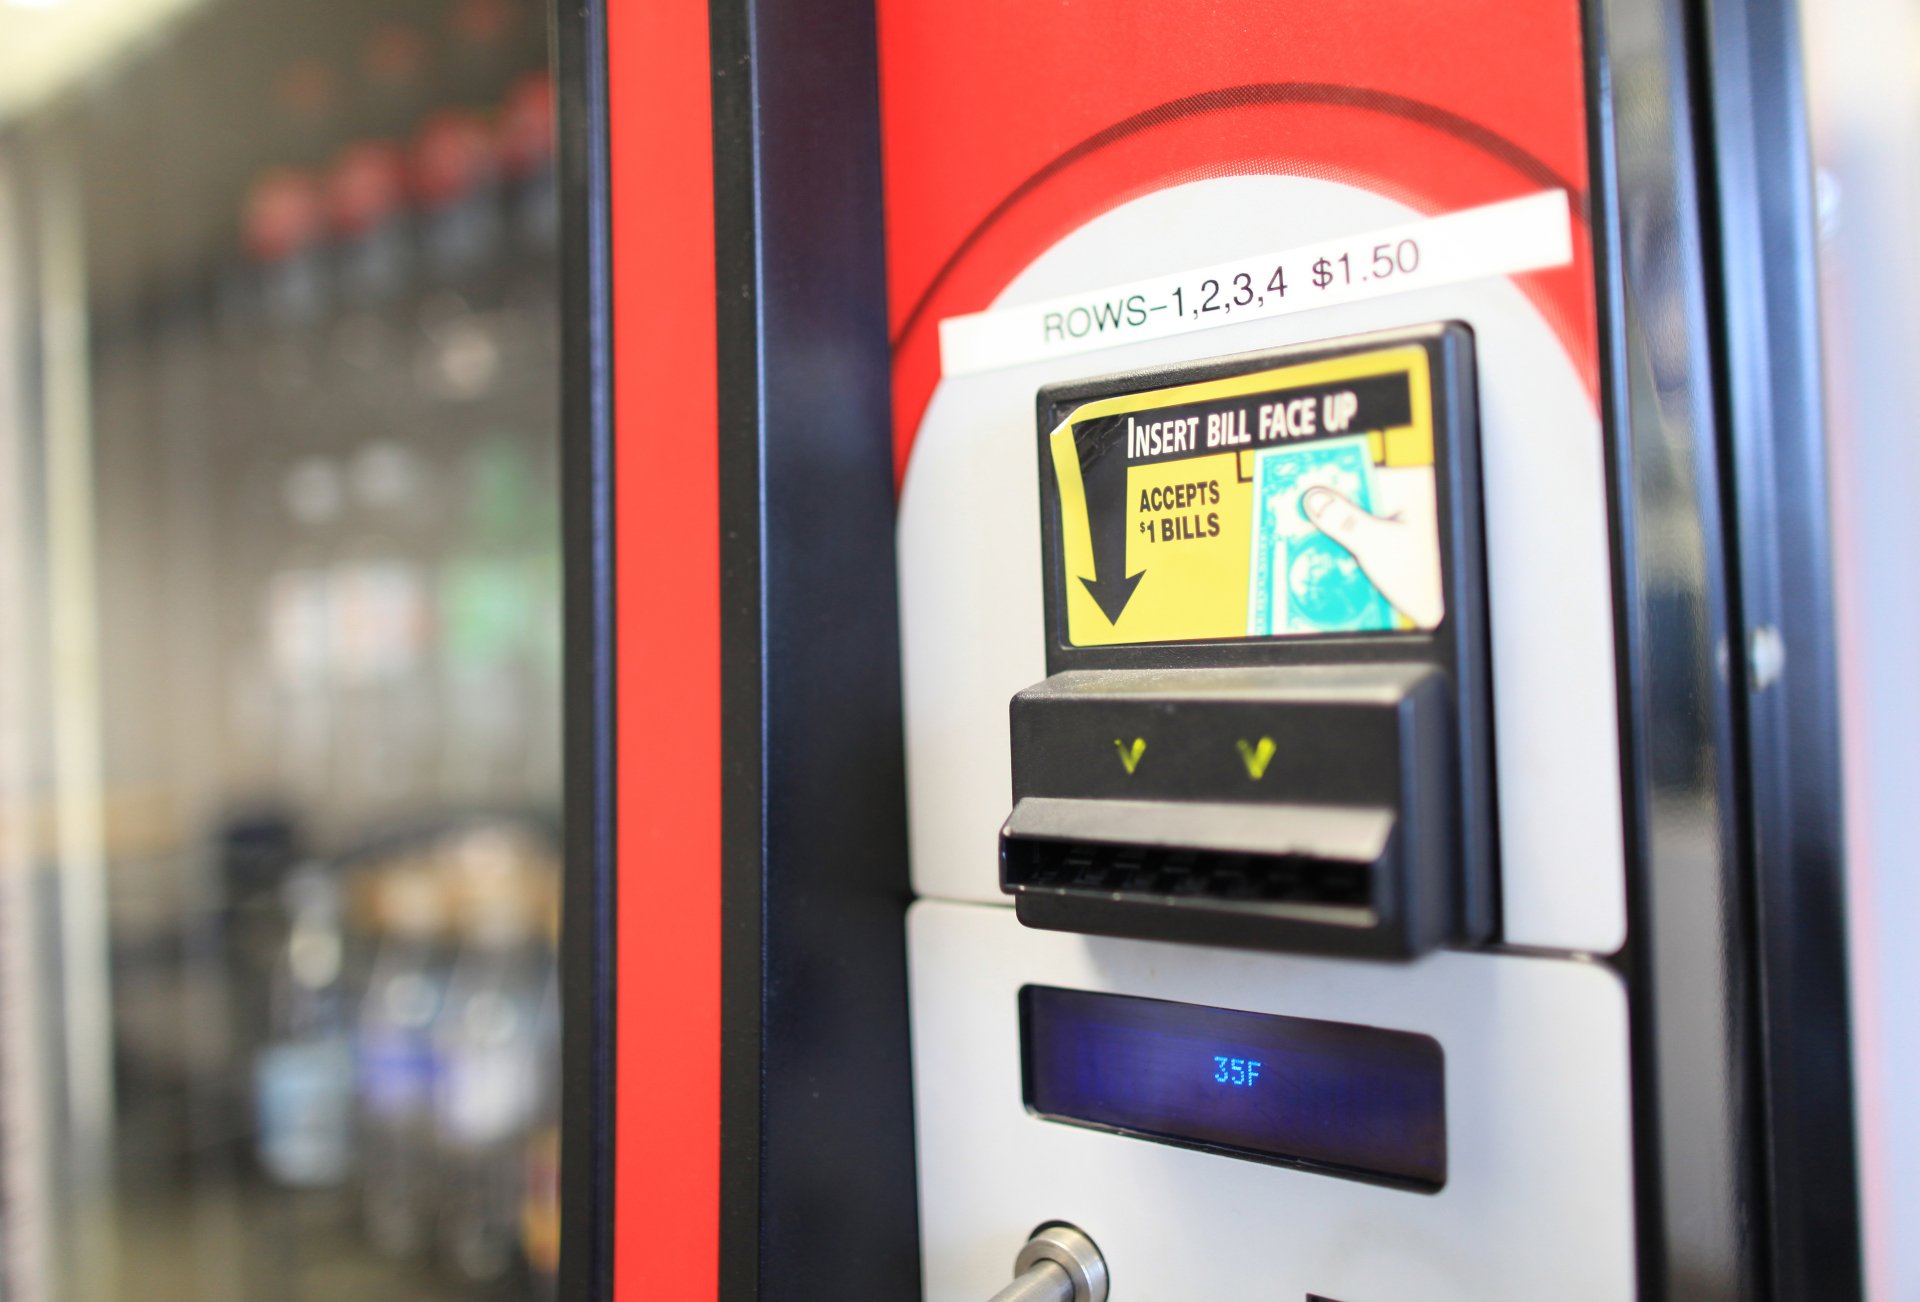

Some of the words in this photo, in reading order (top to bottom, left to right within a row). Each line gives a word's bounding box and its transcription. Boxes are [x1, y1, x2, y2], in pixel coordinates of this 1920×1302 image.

[1043, 266, 1288, 343] ROWS-1,2,3,4
[1311, 238, 1420, 290] $1.50
[1127, 416, 1199, 458] INSERT
[1207, 408, 1251, 447] BILL
[1259, 401, 1316, 439] FACE
[1323, 391, 1358, 432] UP
[1139, 479, 1221, 513] ACCEPTS
[1139, 519, 1156, 543] $1
[1162, 512, 1221, 542] BILLS
[1213, 1055, 1261, 1087] 35F
